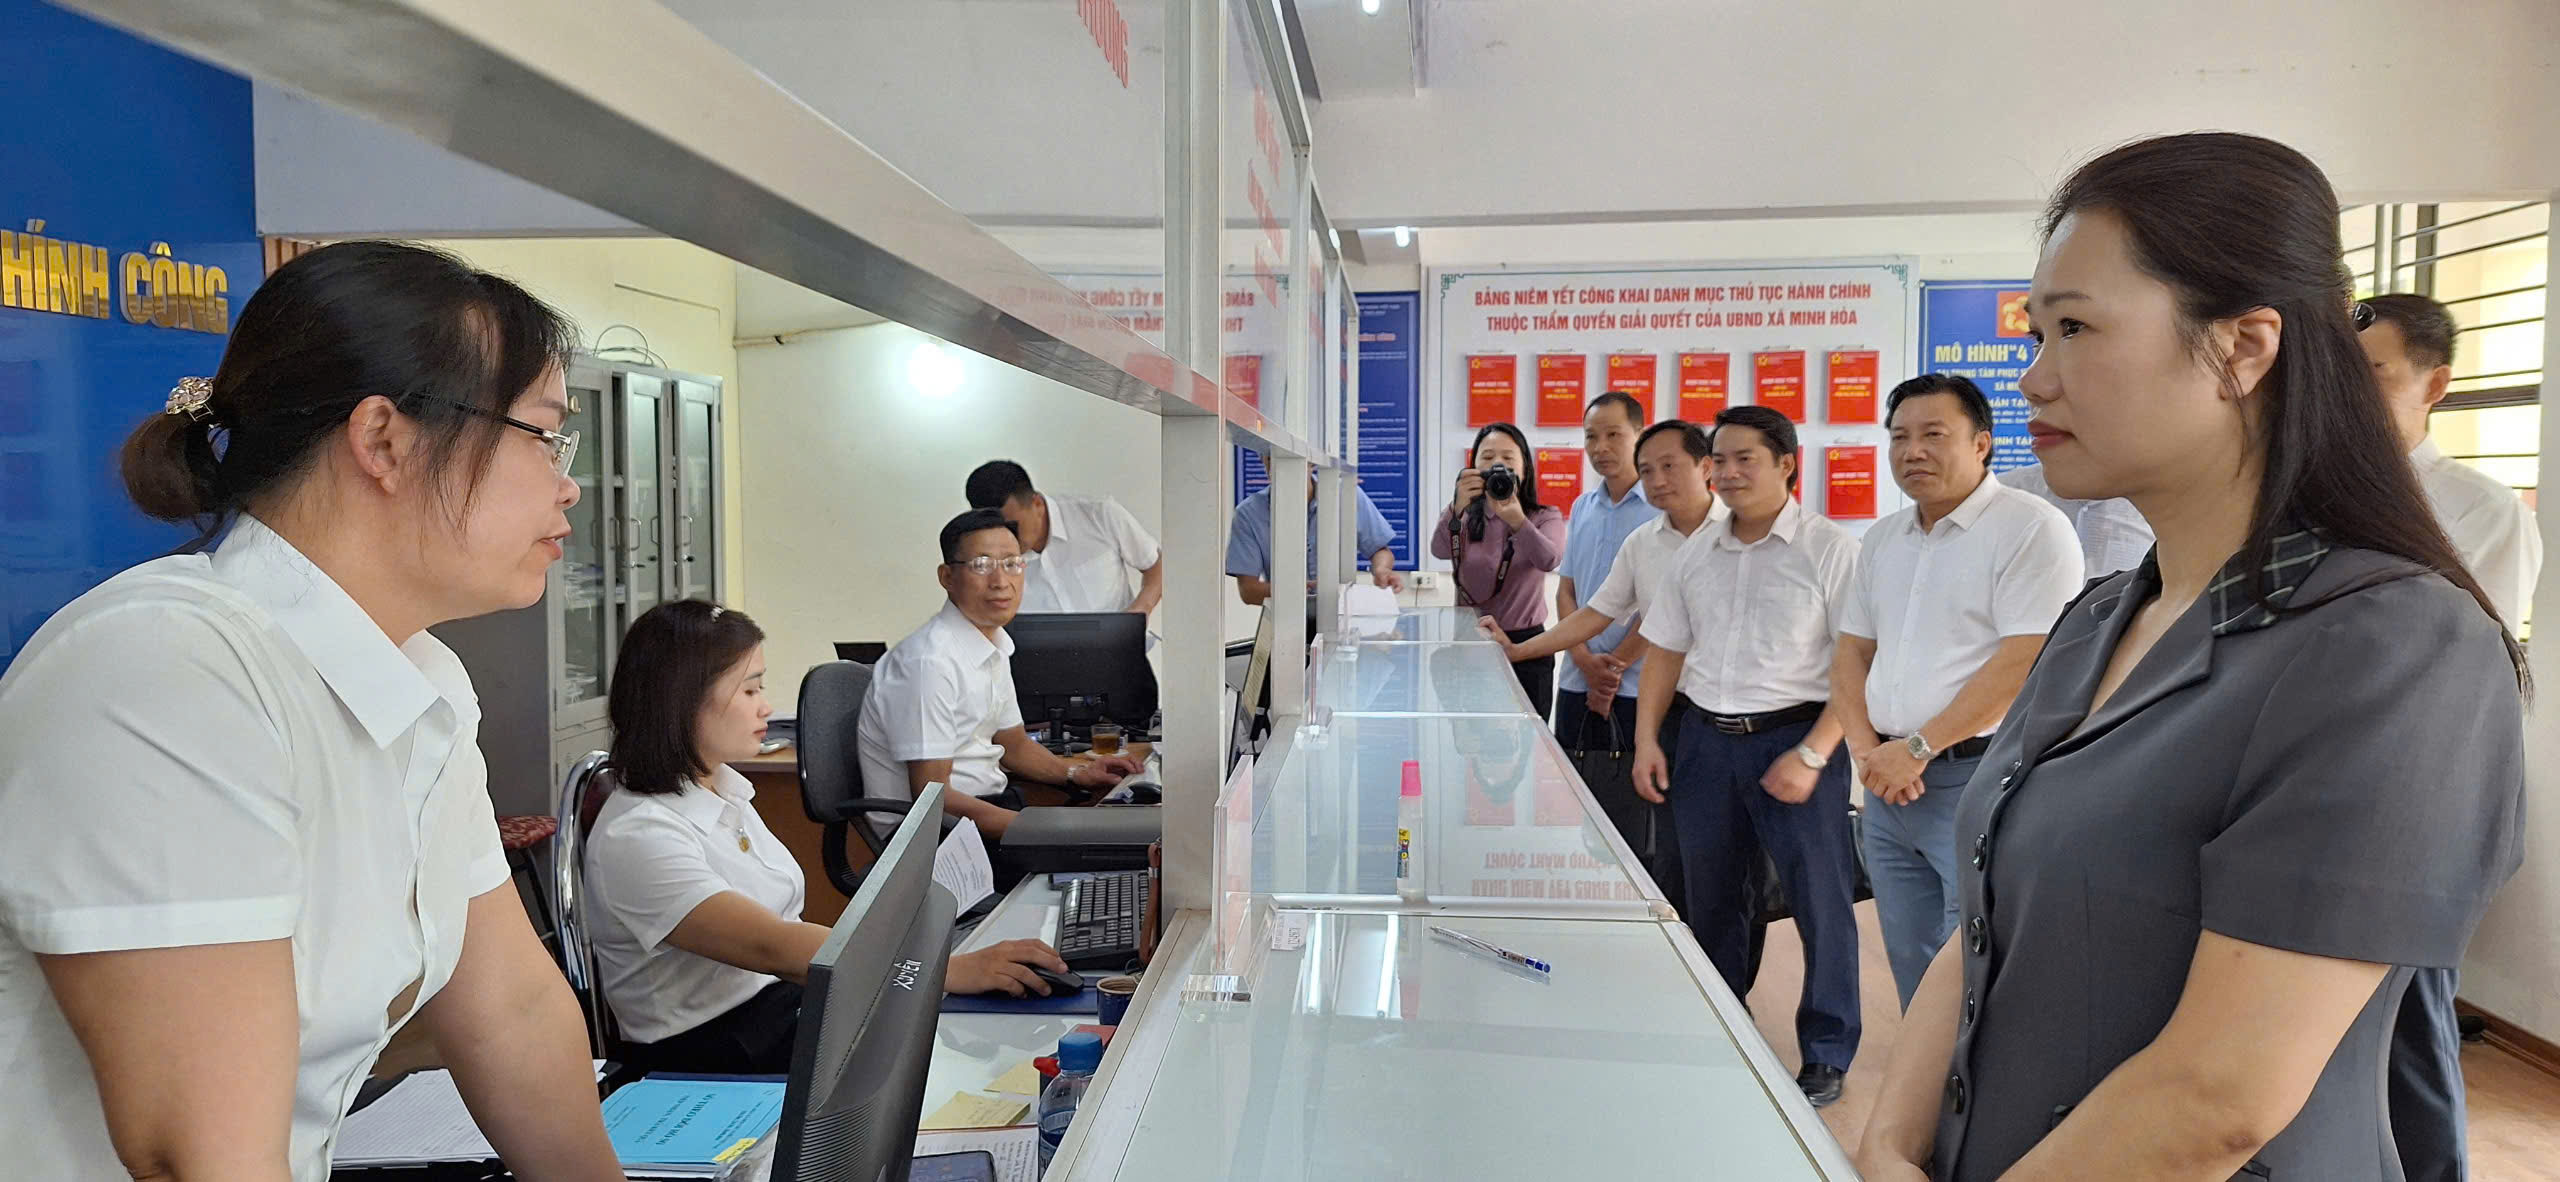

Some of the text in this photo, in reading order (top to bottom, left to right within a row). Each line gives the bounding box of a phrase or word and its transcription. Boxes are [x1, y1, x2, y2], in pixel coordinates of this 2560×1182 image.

[120, 242, 228, 334] CÔNG
[1475, 279, 1871, 306] BẢNG NIÊM YẾT CÔNG KHAI DANH MỤC THỦ TỤC HÀNH CHÍNH
[1487, 312, 1528, 335] THUỘC
[1533, 309, 1568, 331] THẨM
[1573, 312, 1615, 331] QUYỀN
[1620, 308, 1646, 329] GIẢI
[1650, 307, 1691, 328] QUYẾT
[1696, 307, 1722, 328] CỦA
[1727, 311, 1762, 327] UBND
[1767, 308, 1785, 326] XÃ
[1789, 310, 1825, 326] MINH
[1935, 341, 1961, 363] MÔ
